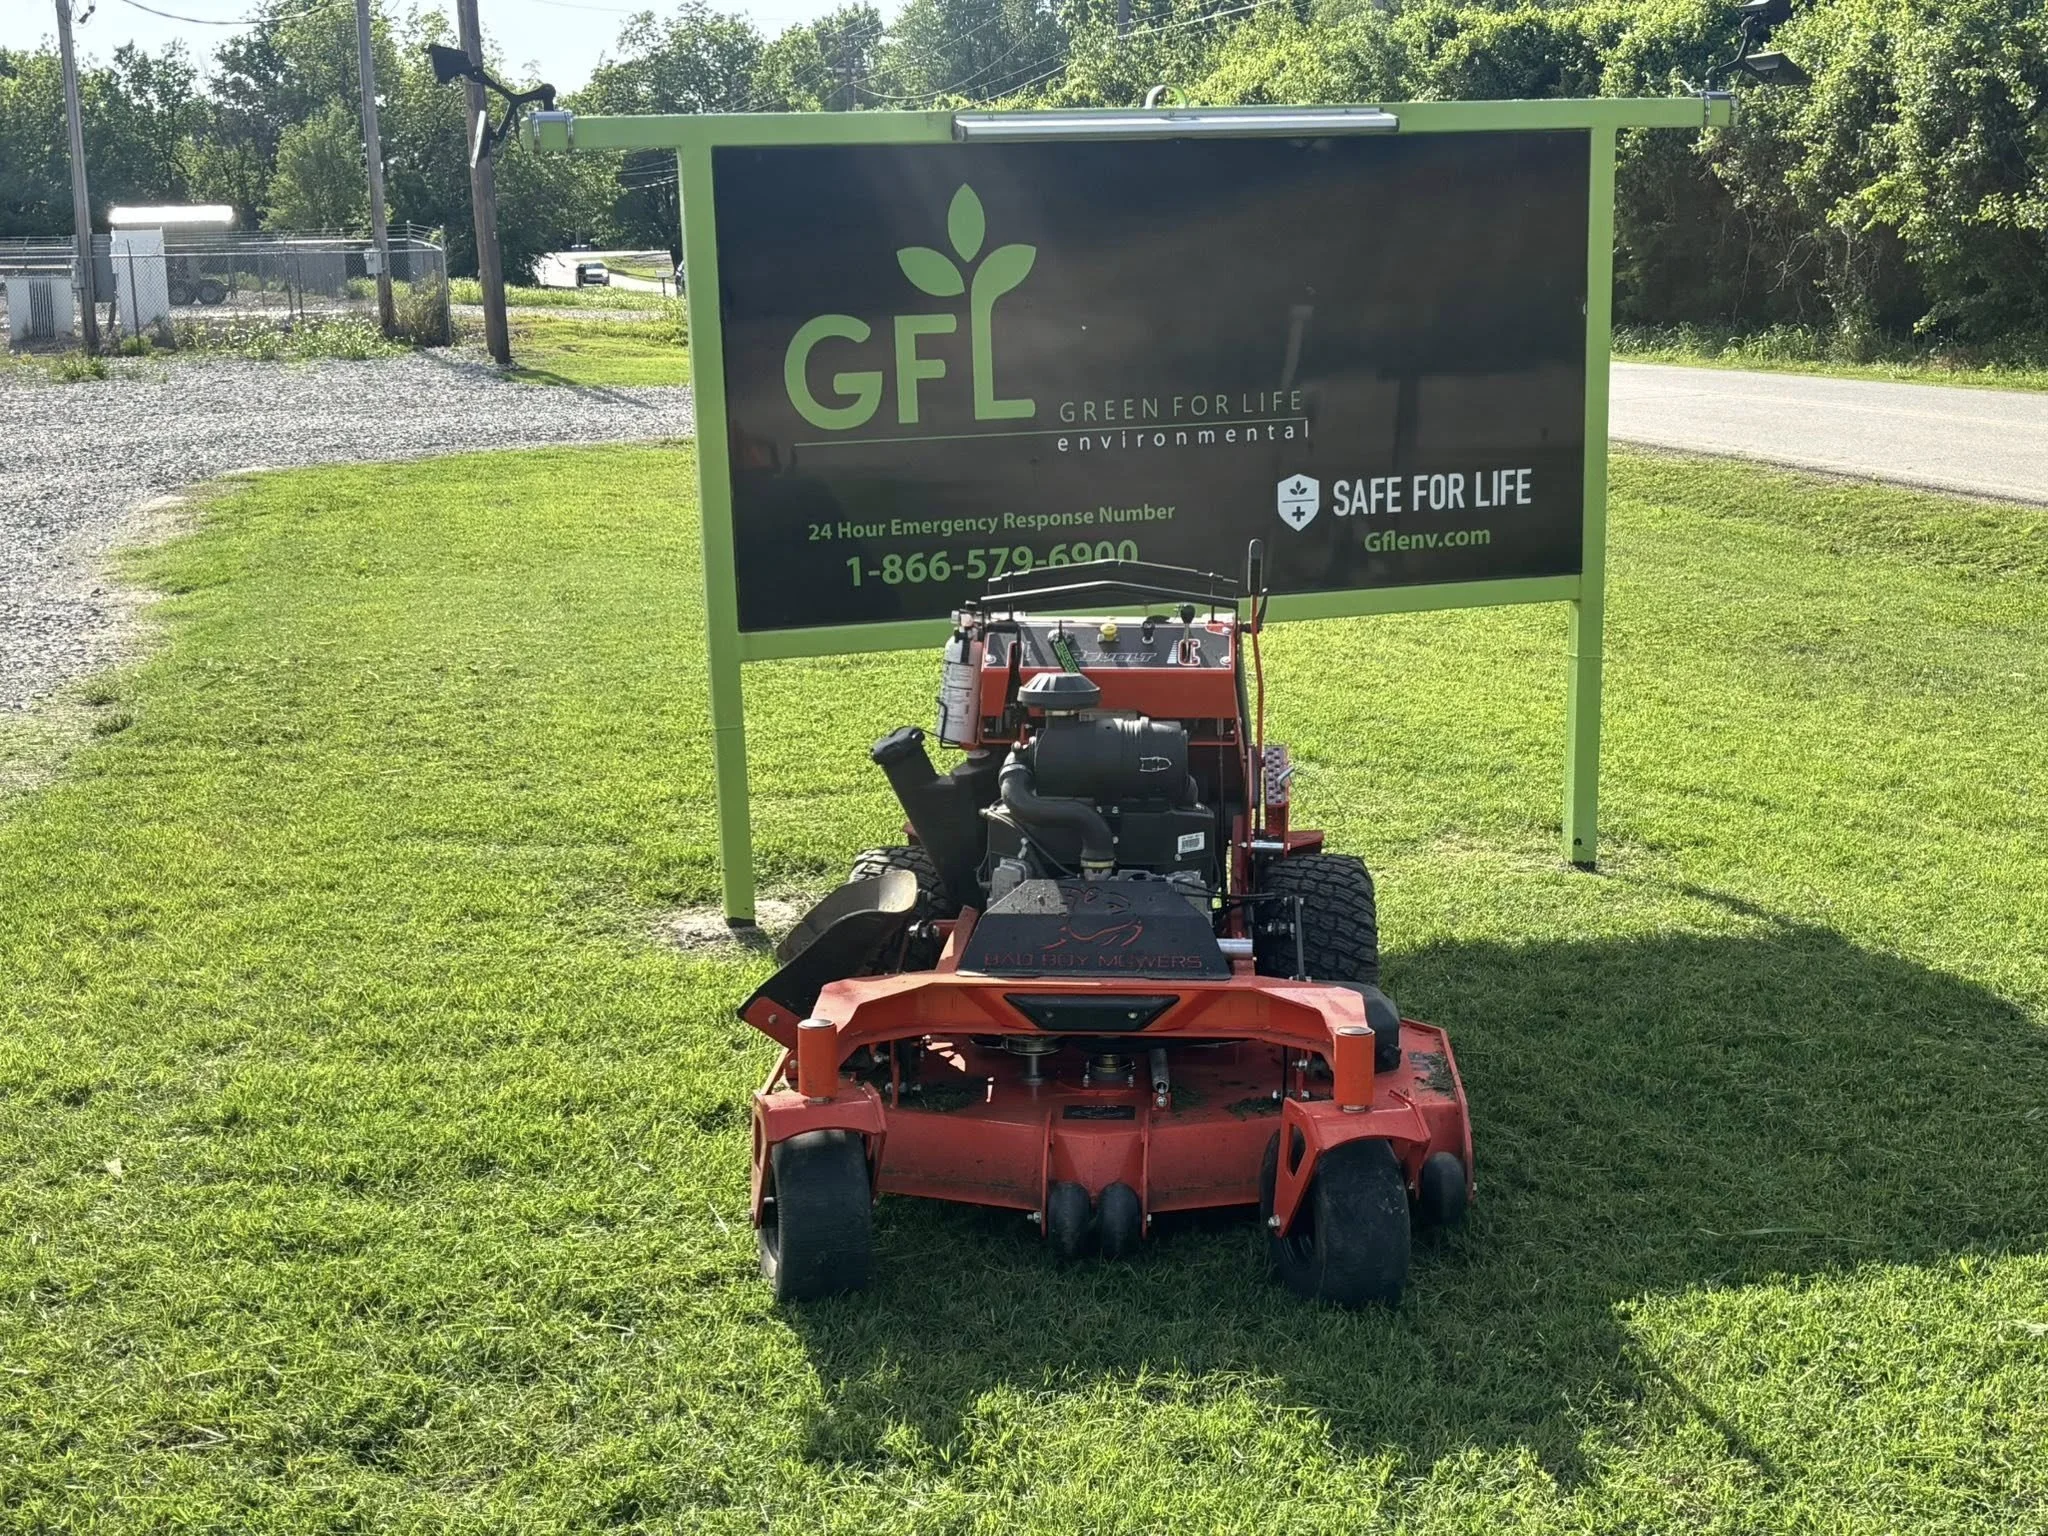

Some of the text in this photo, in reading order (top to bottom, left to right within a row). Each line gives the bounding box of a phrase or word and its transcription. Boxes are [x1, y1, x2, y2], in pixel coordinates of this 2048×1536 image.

[784, 244, 1036, 430] GFL
[1060, 390, 1301, 422] GREEN FOR LIFE
[1057, 419, 1309, 451] environmental
[1333, 468, 1532, 517] SAFE FOR LIFE
[808, 503, 1176, 540] 24 Hour Emergency Response Number
[1364, 528, 1491, 552] Gflenv.com
[846, 539, 1138, 586] 1-866-579-6900
[984, 953, 1203, 969] BAD BOY MOWERS
